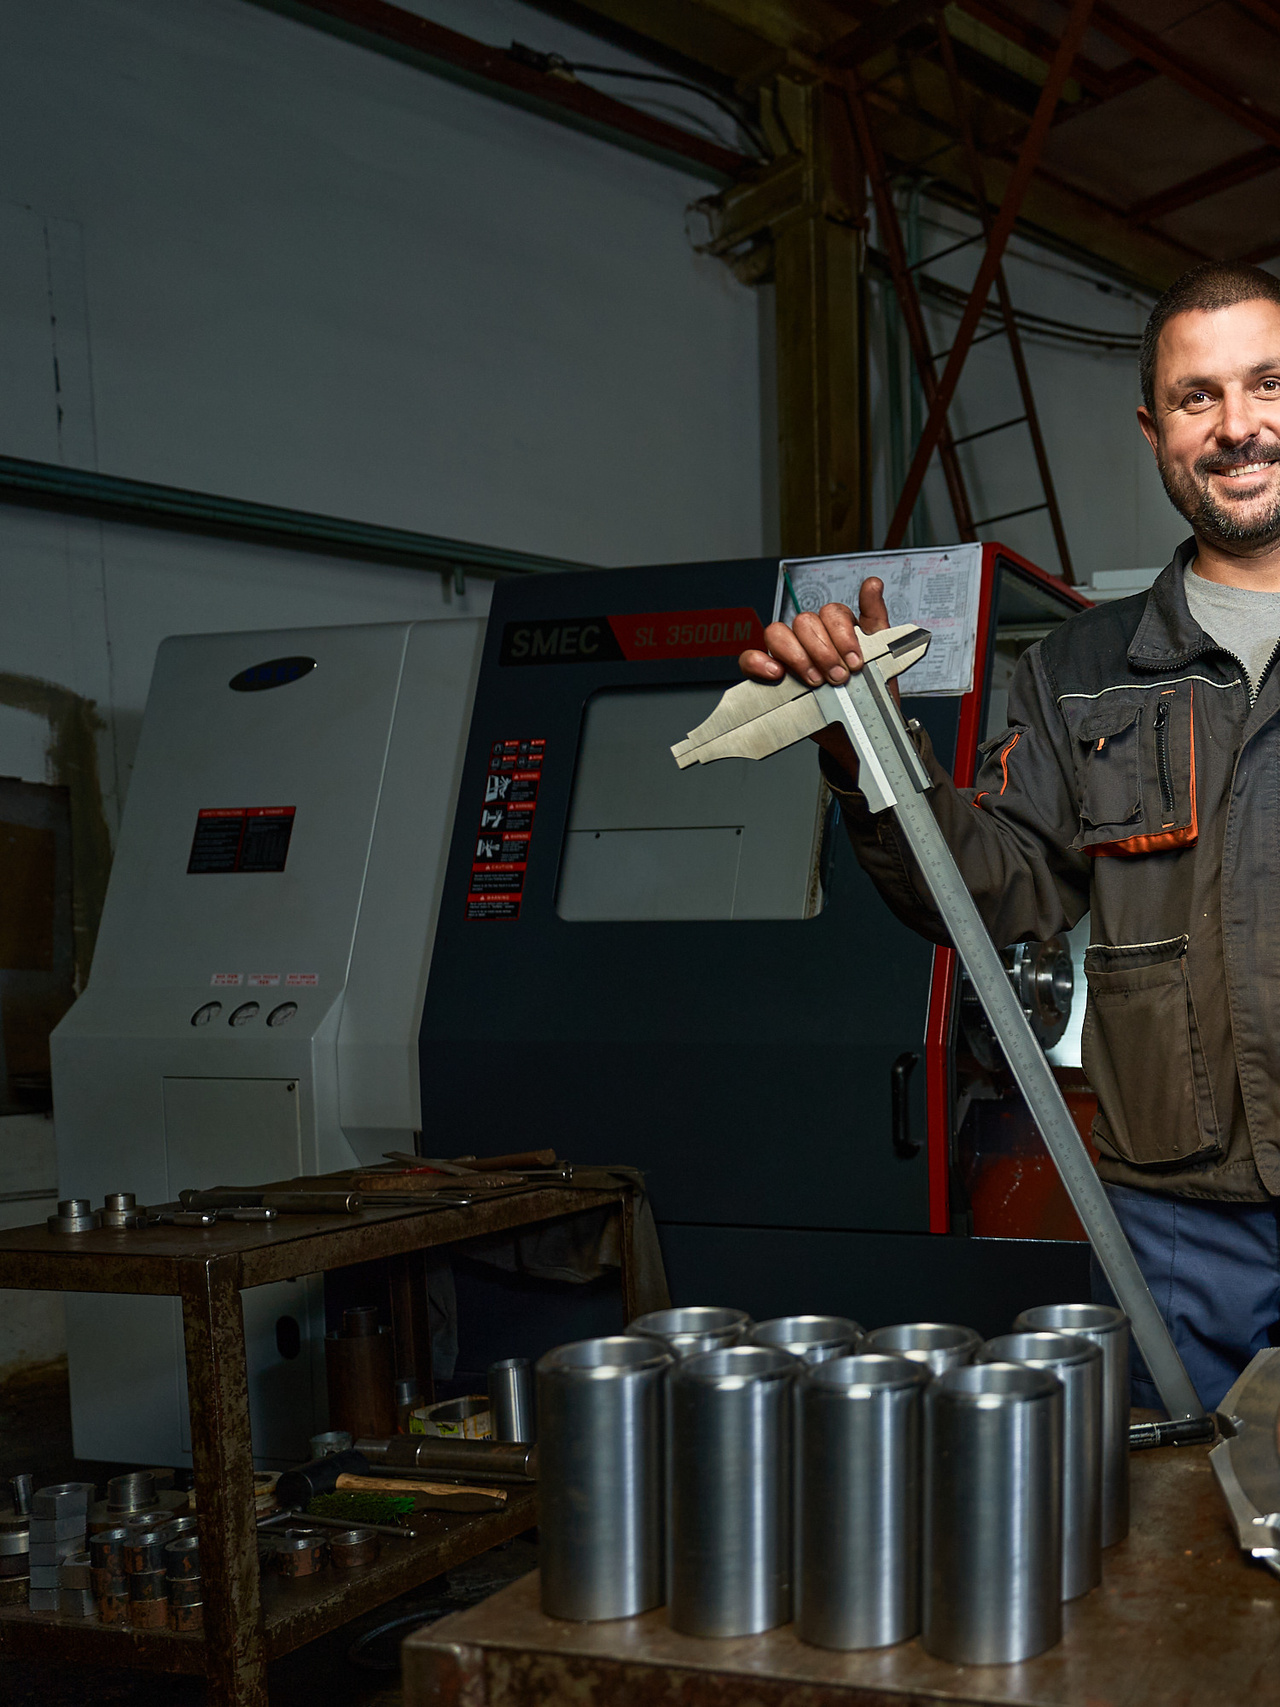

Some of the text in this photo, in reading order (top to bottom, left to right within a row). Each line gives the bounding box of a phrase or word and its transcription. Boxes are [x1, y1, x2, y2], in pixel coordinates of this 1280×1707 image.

[510, 621, 752, 659] SMEC SL 3500LM
[244, 665, 300, 682] SMEC
